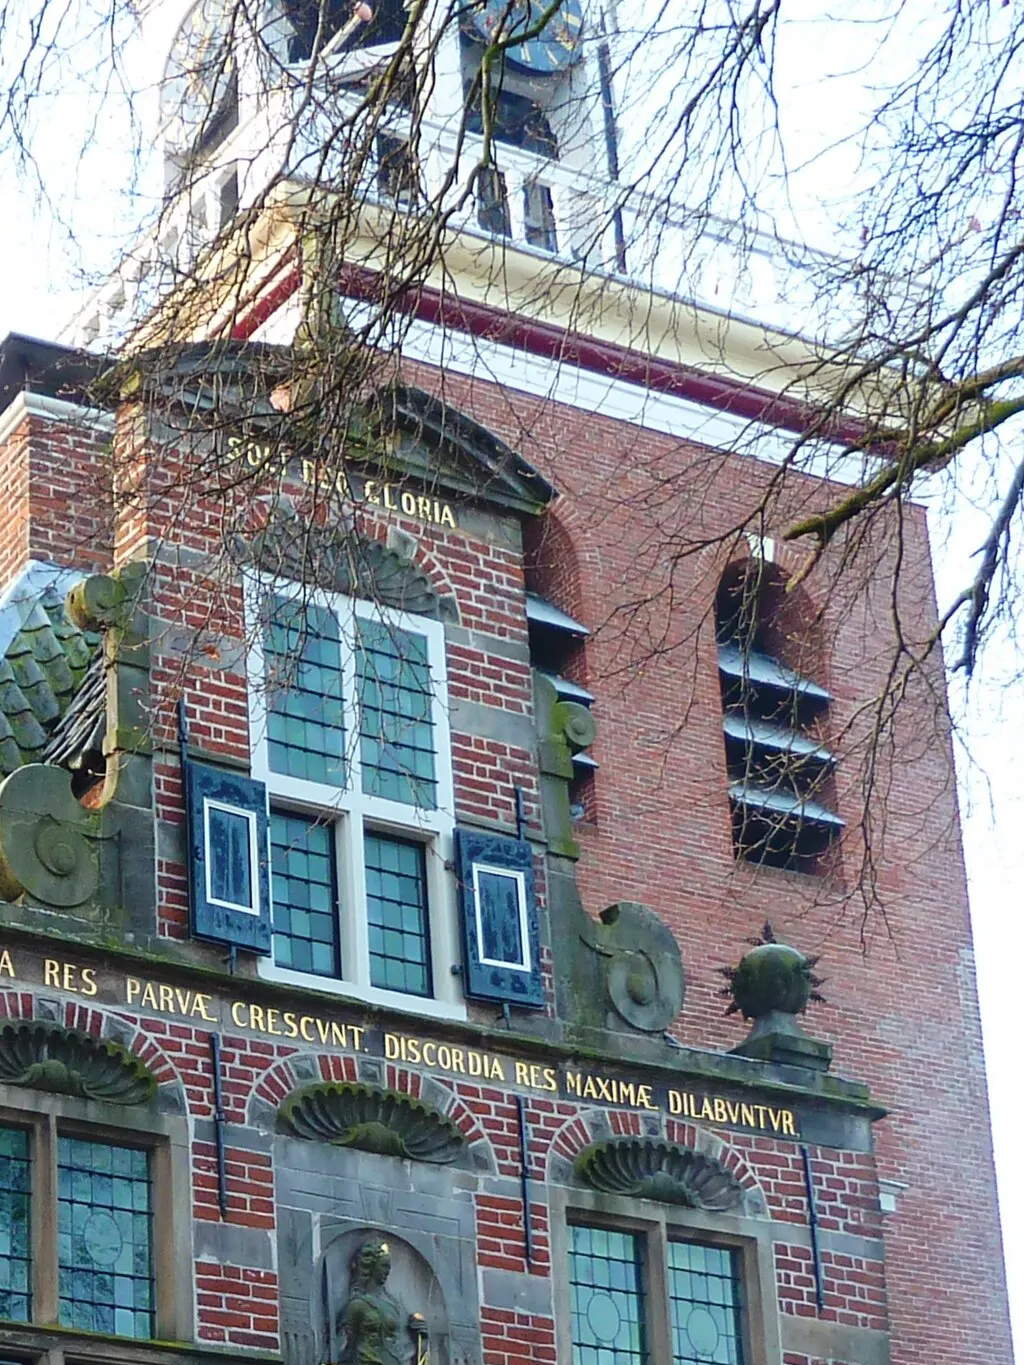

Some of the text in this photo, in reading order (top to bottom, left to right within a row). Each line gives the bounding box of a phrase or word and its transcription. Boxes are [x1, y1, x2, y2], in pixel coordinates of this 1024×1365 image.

[364, 480, 456, 528] GLORIA
[44, 958, 98, 996] RES
[231, 1001, 369, 1053] CRESCVNT.
[384, 1033, 506, 1081] DISCORDIA
[514, 1061, 557, 1092] RES
